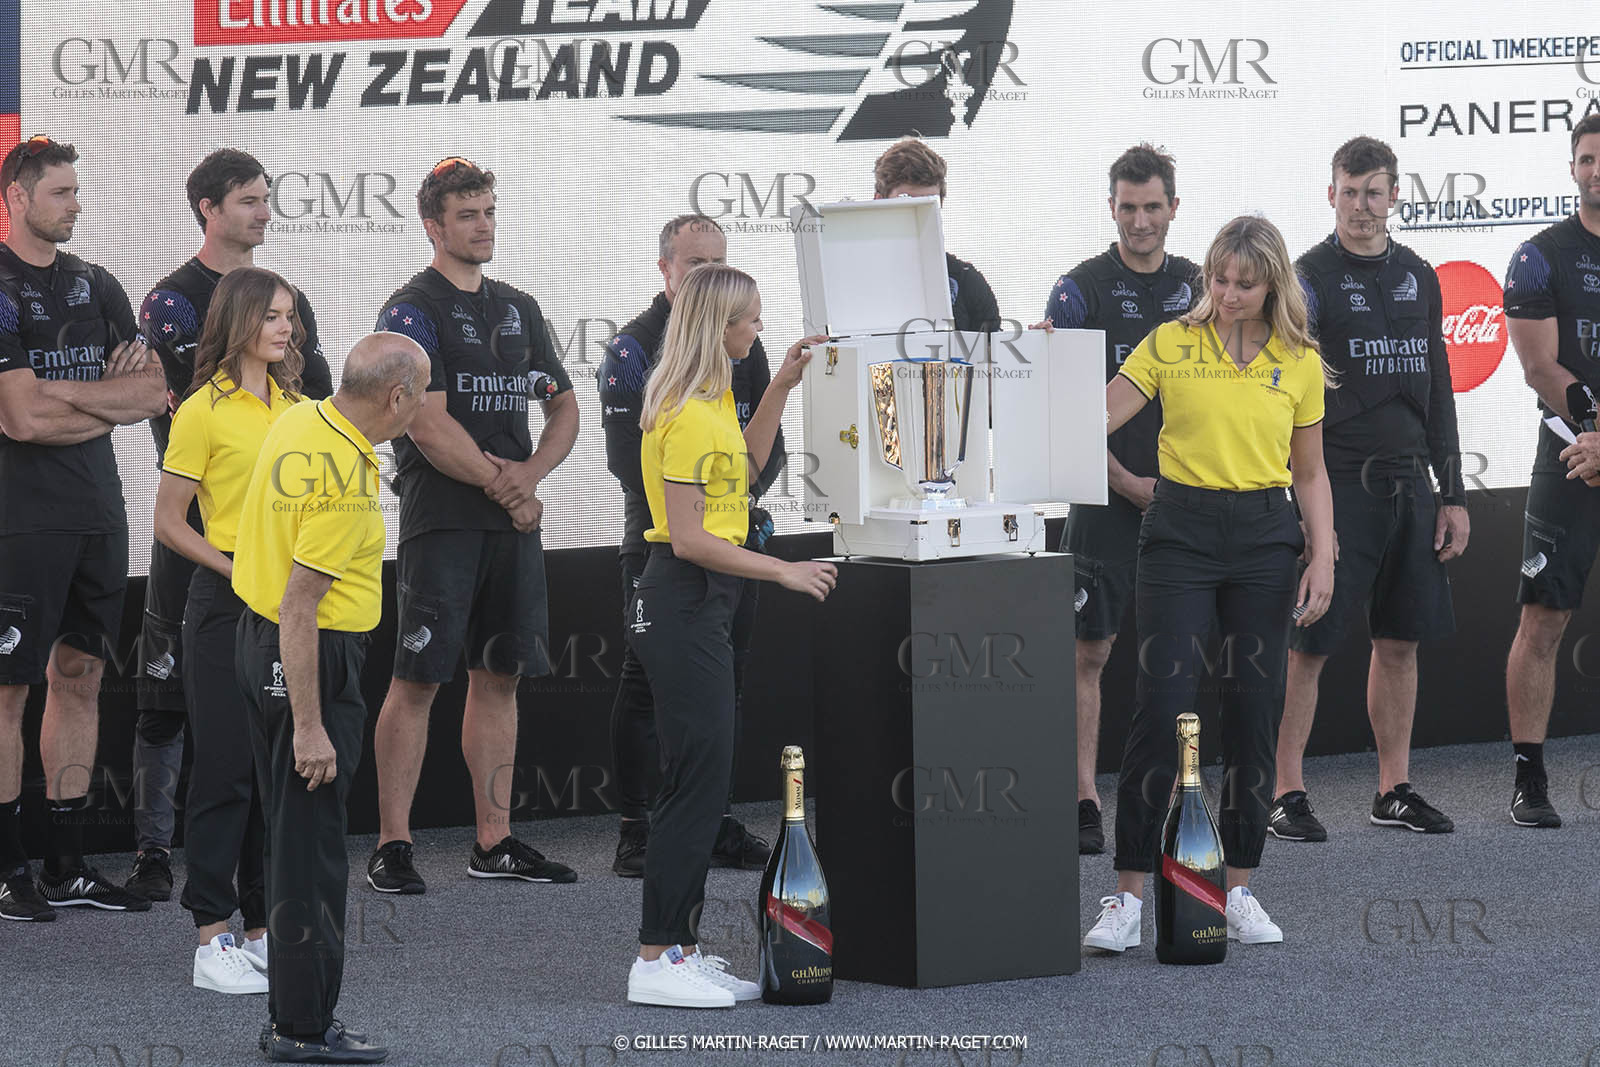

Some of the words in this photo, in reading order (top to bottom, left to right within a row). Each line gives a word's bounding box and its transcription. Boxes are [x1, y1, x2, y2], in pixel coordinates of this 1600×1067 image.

[1401, 40, 1488, 62] OFFICIAL
[186, 52, 347, 115] NEW
[360, 41, 681, 107] ZEALAND
[1401, 200, 1486, 224] OFFICIAL
[1348, 336, 1428, 358] Emirates
[1365, 358, 1385, 376] FLY
[1387, 357, 1427, 374] BETTER
[472, 395, 493, 412] FLY
